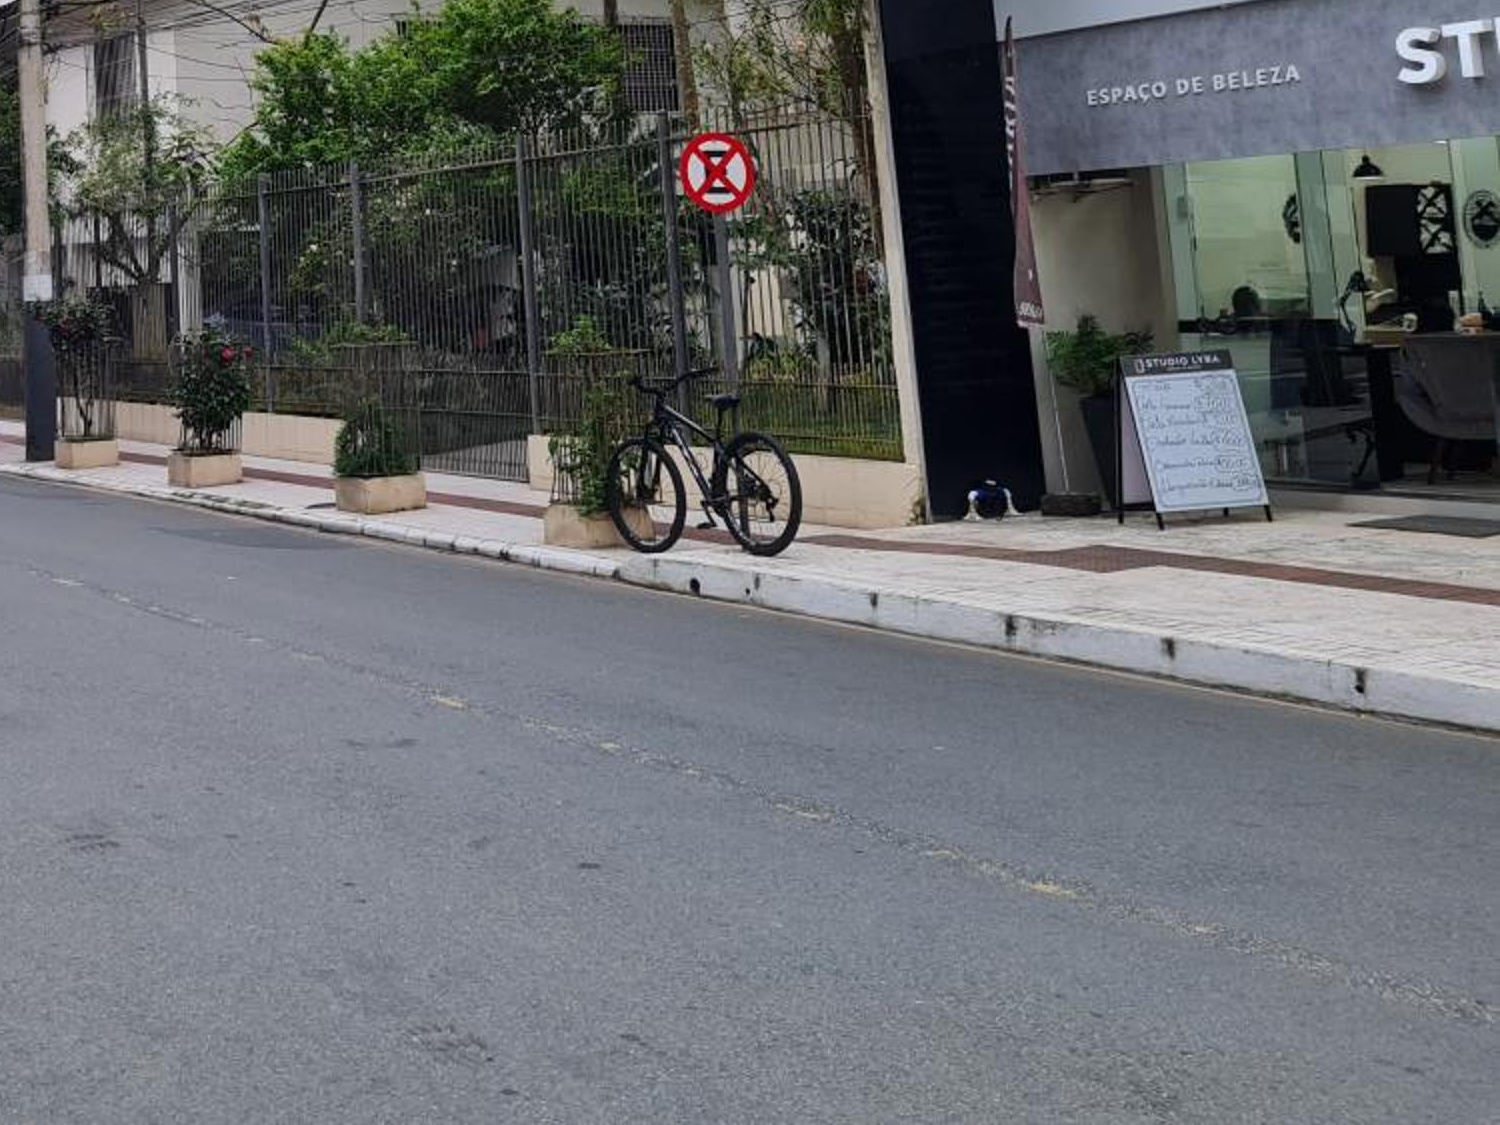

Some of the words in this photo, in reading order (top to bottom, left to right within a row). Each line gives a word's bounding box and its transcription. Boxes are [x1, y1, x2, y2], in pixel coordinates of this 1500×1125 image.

[1394, 16, 1500, 86] ST
[1087, 80, 1167, 107] ESPAÇO
[1176, 75, 1204, 94] DE
[1212, 63, 1301, 91] BELEZA
[1145, 356, 1188, 367] STUDIO
